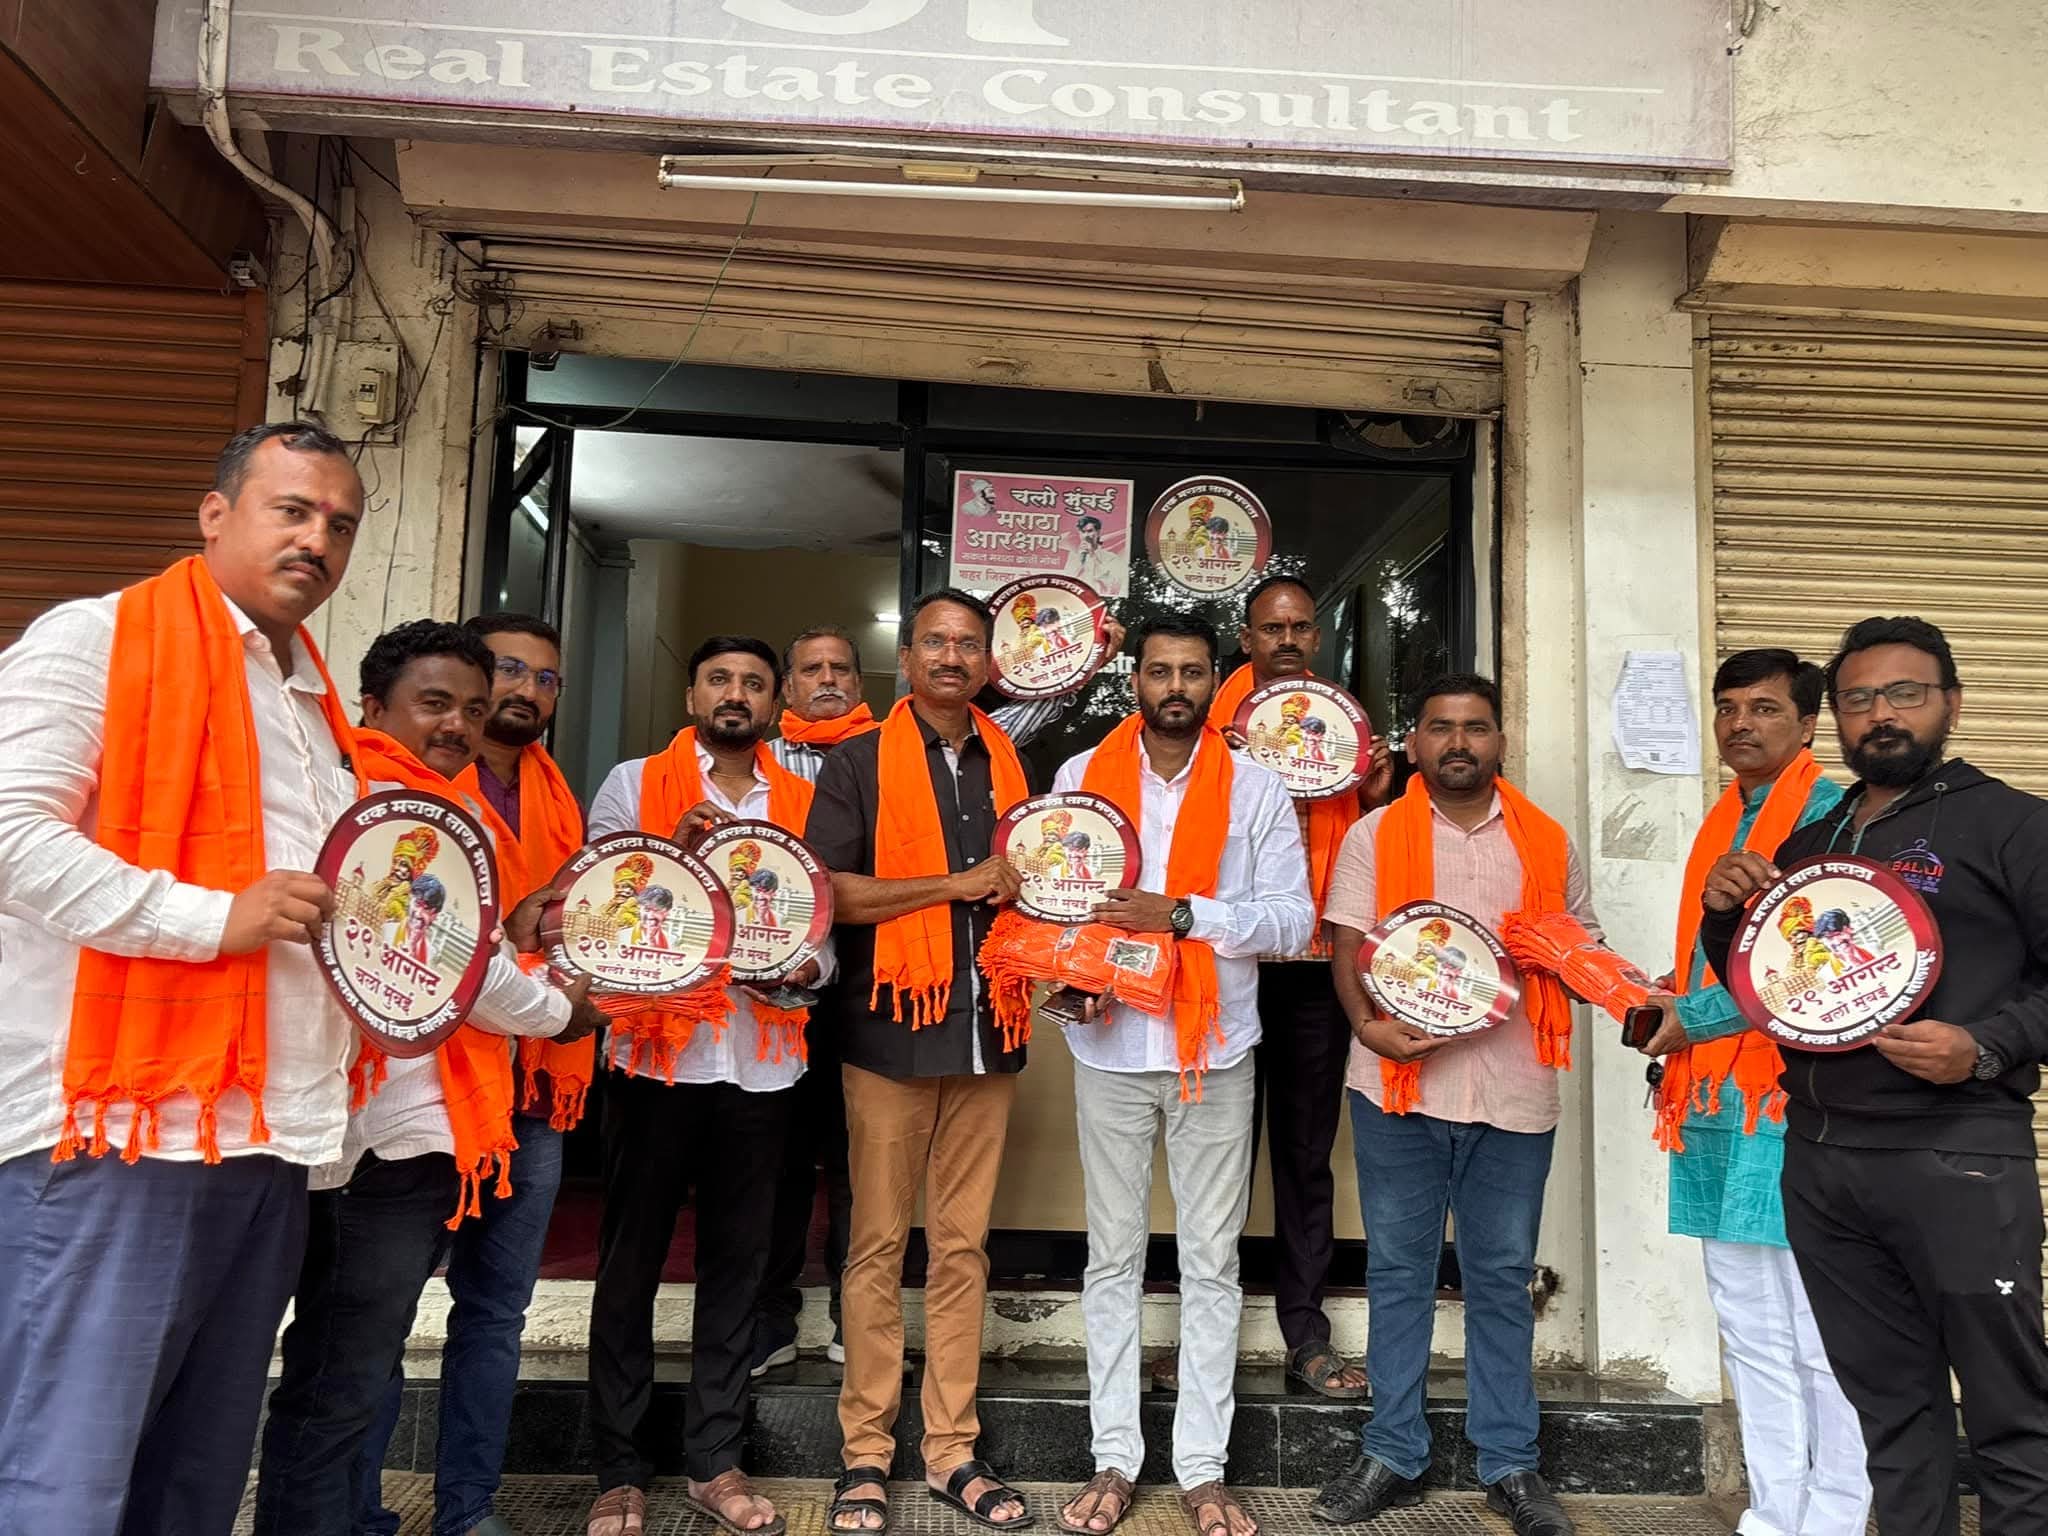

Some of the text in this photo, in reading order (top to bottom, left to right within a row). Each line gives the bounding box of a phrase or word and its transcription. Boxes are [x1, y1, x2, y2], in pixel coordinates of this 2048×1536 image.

[267, 24, 1585, 144] Real Estate Consultant
[996, 511, 1061, 531] मराठा
[1010, 486, 1117, 515] चलो मुंबई
[964, 529, 1062, 552] आरक्षण
[355, 800, 389, 826] एक
[390, 800, 444, 820] मराठा
[445, 811, 478, 850] लाख
[570, 851, 598, 873] एक
[598, 837, 645, 852] मराठा
[682, 854, 719, 892] मराठा
[1738, 862, 1876, 953] एक मराठा लाख मराठा
[346, 918, 372, 959] २९
[578, 936, 608, 959] २९
[1787, 990, 1823, 1015] २९
[1819, 982, 1890, 1024] चलो मुंबई
